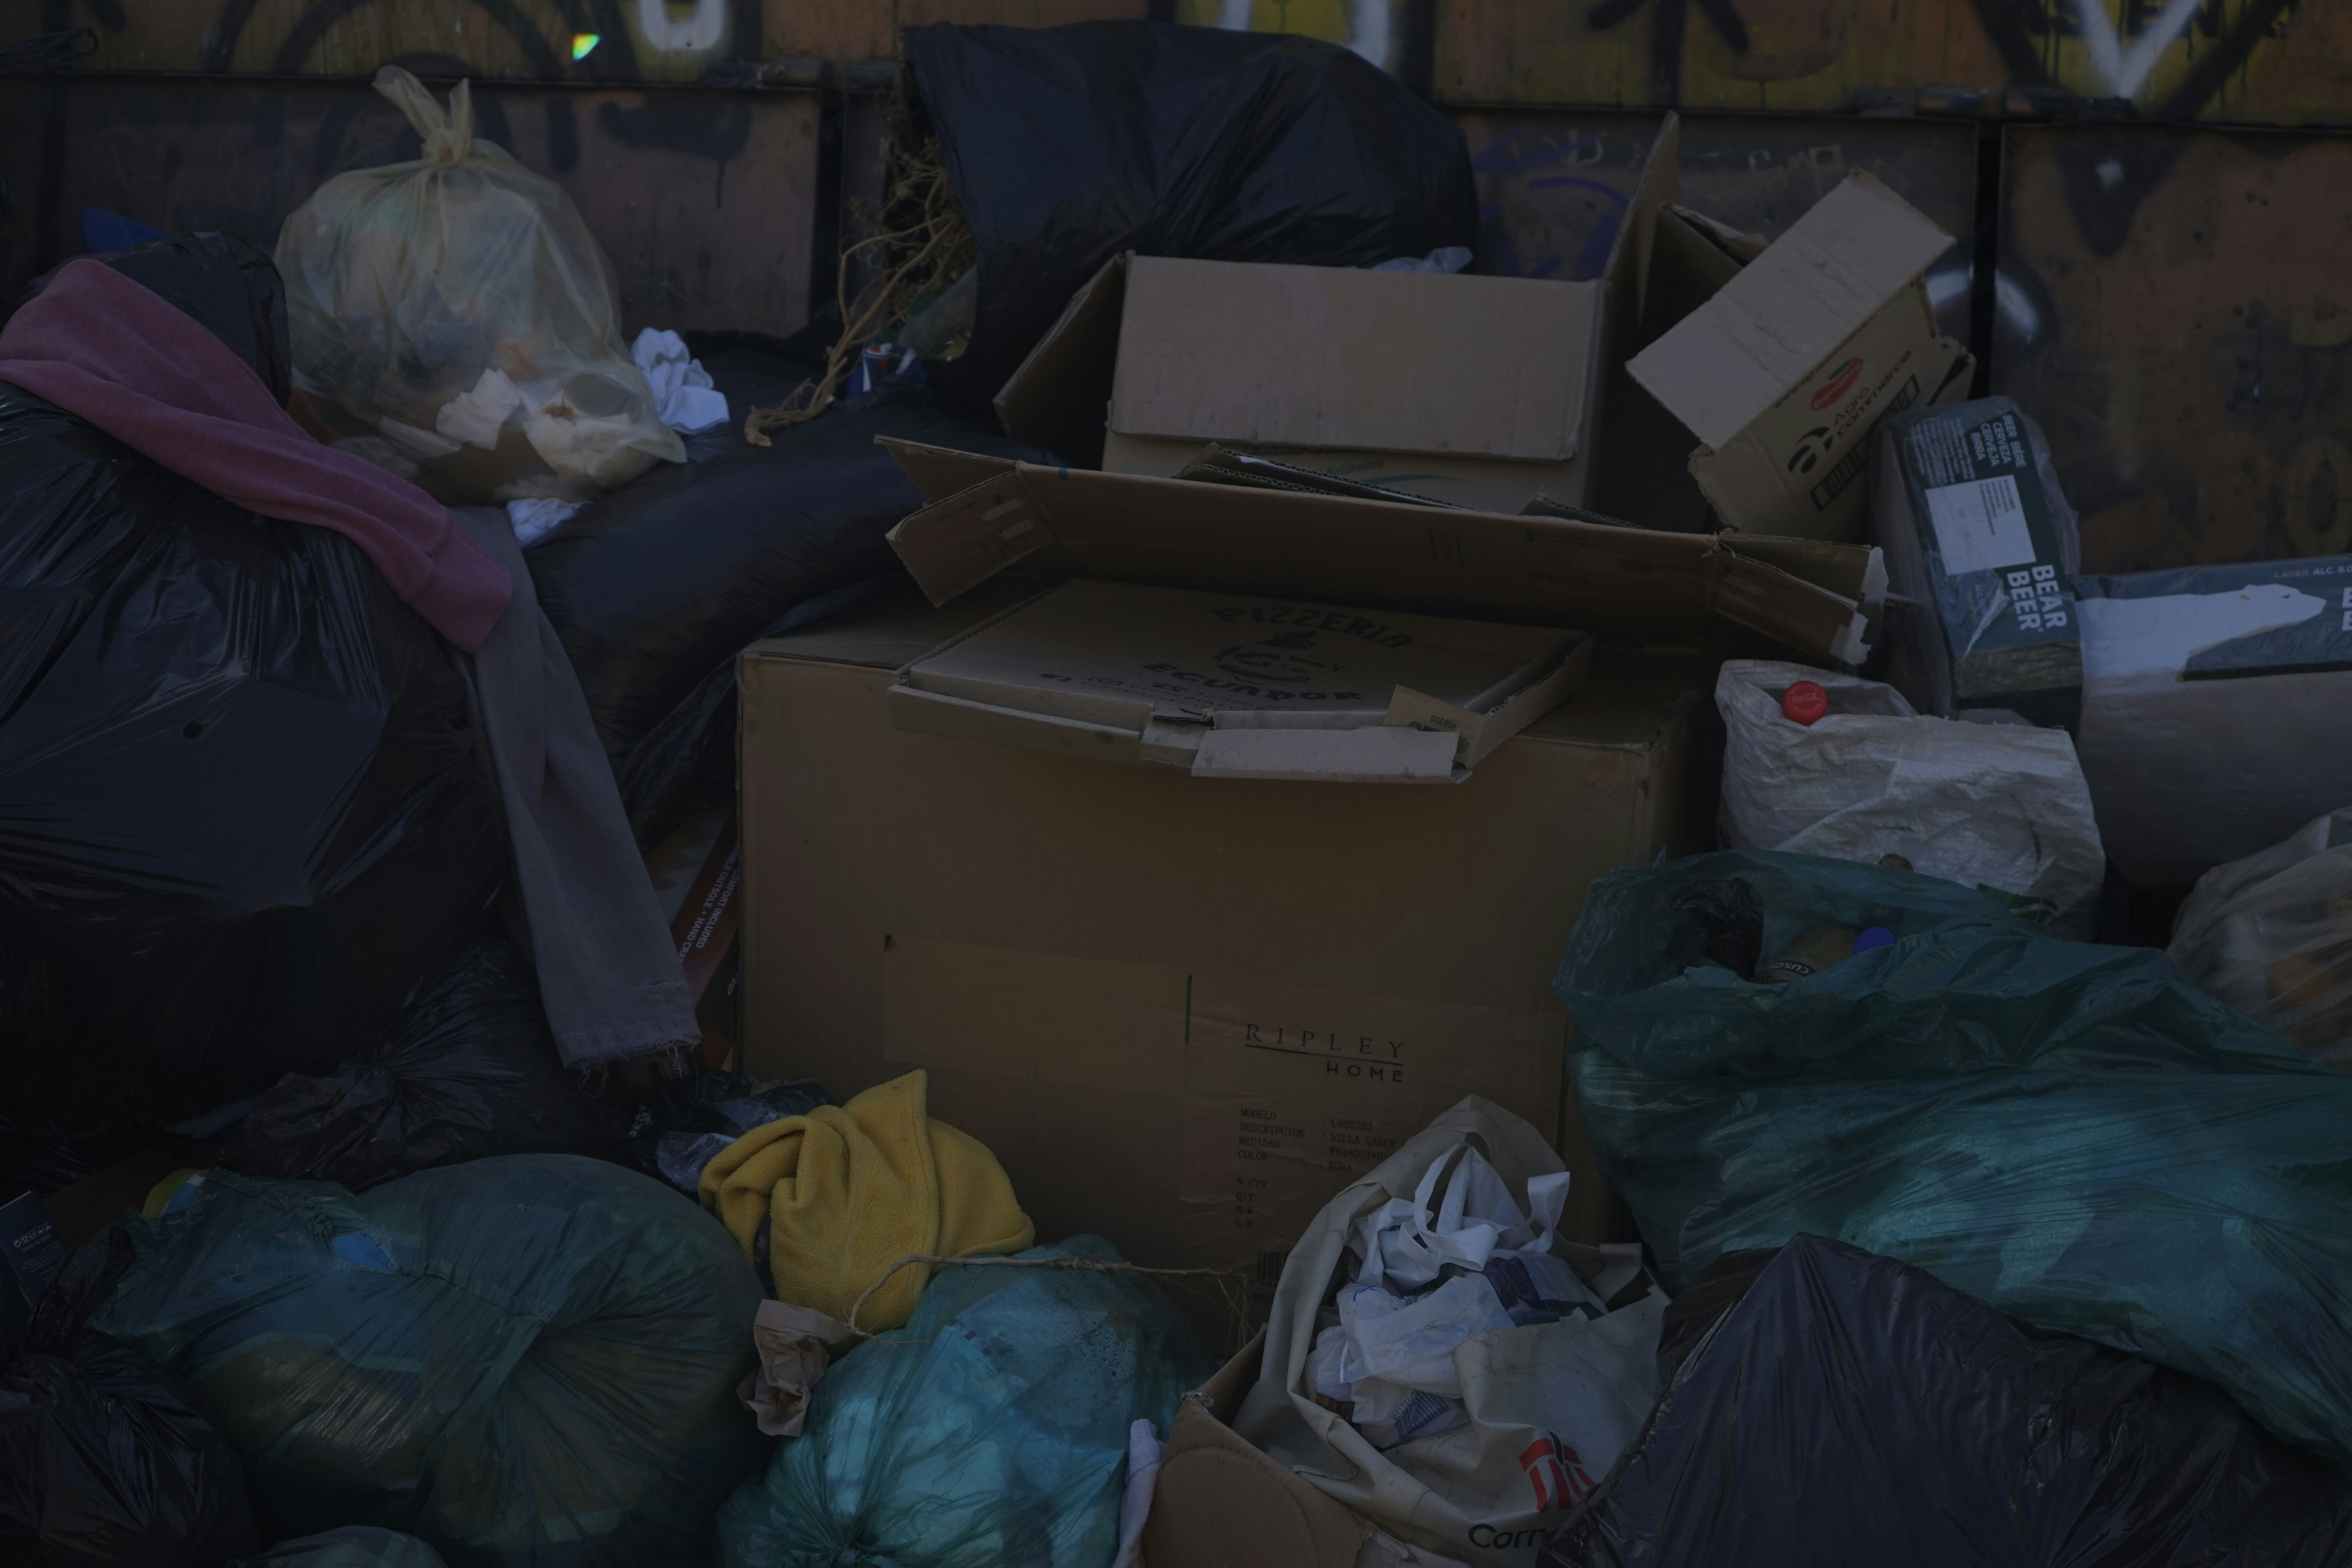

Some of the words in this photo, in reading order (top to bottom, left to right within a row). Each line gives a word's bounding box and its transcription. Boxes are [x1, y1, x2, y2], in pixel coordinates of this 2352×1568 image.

[1835, 387, 1869, 426] Agro
[1838, 350, 1911, 437] commerce
[2003, 414, 2018, 438] BEER
[1971, 432, 1985, 461] BIRRA
[1981, 423, 2000, 467] CERVEJA
[1993, 422, 2012, 464] CERVEZA
[2010, 440, 2027, 468] BIÈRE
[2275, 569, 2309, 579] LAGER
[2312, 567, 2335, 575] ALC.
[2007, 570, 2041, 630] BEER
[2031, 564, 2067, 628] BEAR
[1210, 608, 1412, 648] PIZZERIA
[1140, 662, 1365, 701] ECUADOR
[1430, 715, 1457, 730] 459300
[703, 871, 728, 908] OUTSOLE
[687, 917, 704, 941] HAND
[696, 907, 723, 948] INCLUDED
[1245, 1024, 1405, 1058] RIPLEY
[1327, 1061, 1404, 1082] HOME
[1241, 1107, 1276, 1120] MODELO
[1331, 1118, 1372, 1131] L502792
[1238, 1136, 1280, 1149] MEDIDAS
[1239, 1122, 1305, 1138] DESCRIPCION
[1330, 1132, 1360, 1145] SILLA
[1365, 1136, 1396, 1148] GAMER
[1238, 1150, 1268, 1162] COLOR
[1328, 1160, 1352, 1172] ROSA
[1236, 1191, 1254, 1201] QTY
[1248, 1179, 1266, 1189] CTN
